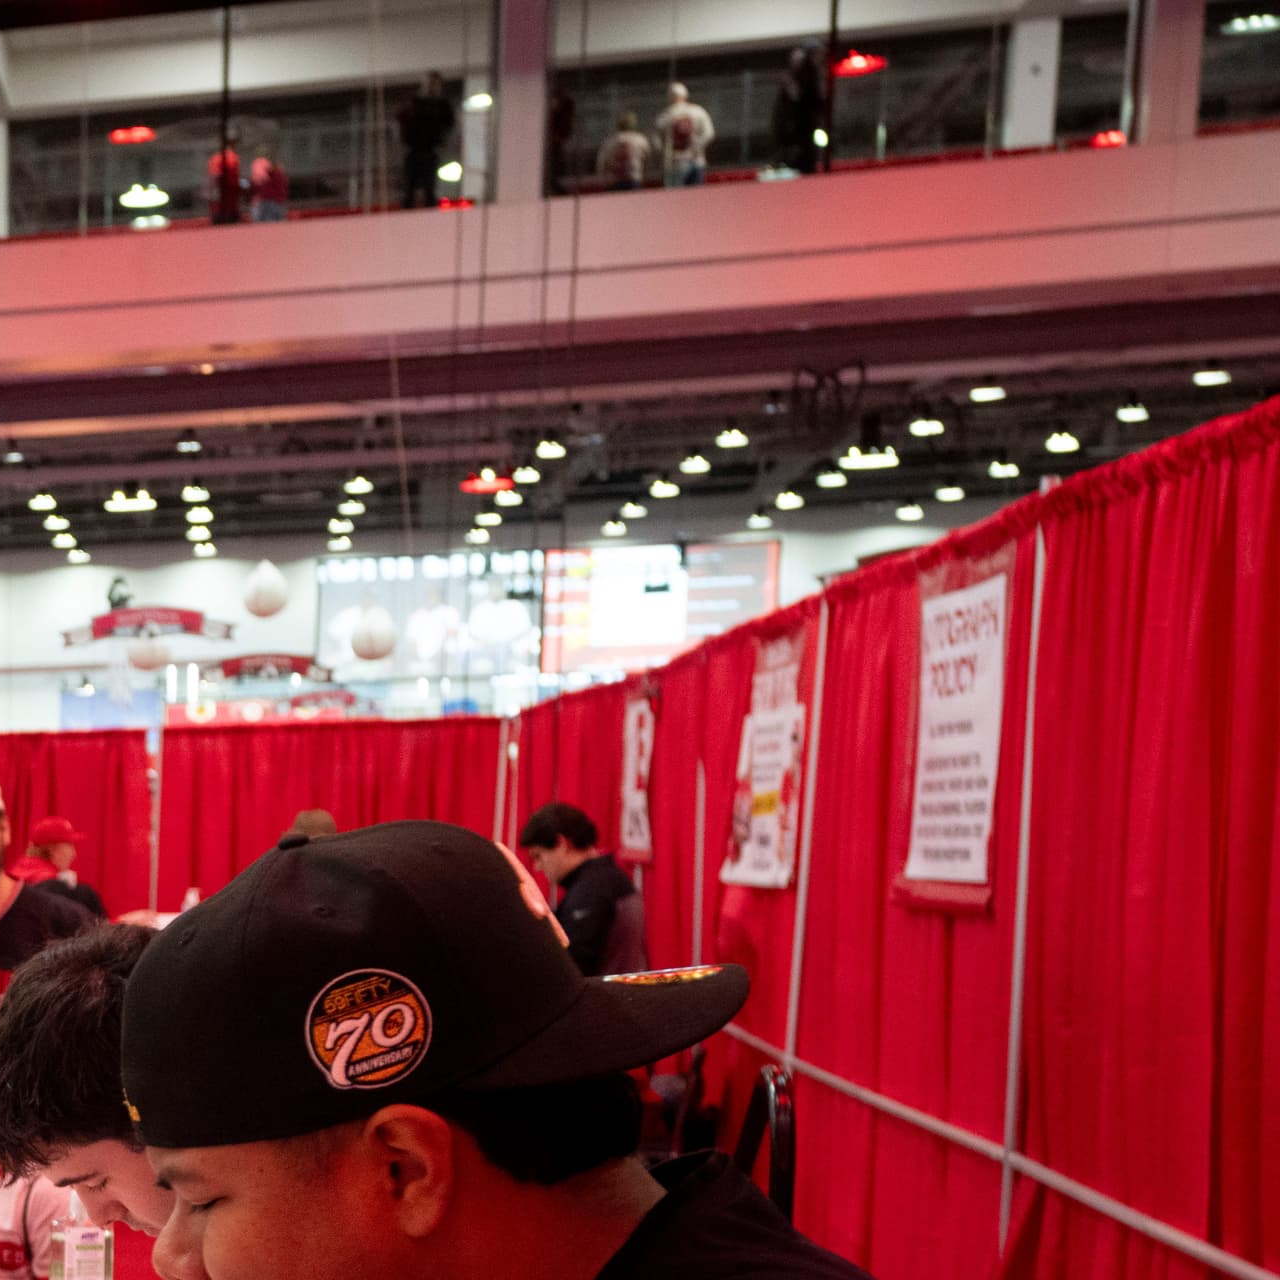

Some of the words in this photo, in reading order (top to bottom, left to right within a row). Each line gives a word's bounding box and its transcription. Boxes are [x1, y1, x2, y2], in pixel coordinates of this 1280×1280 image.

[324, 979, 392, 1014] 59FIFTY
[325, 1003, 415, 1086] 70
[348, 1045, 415, 1077] ANNIVERSARY
